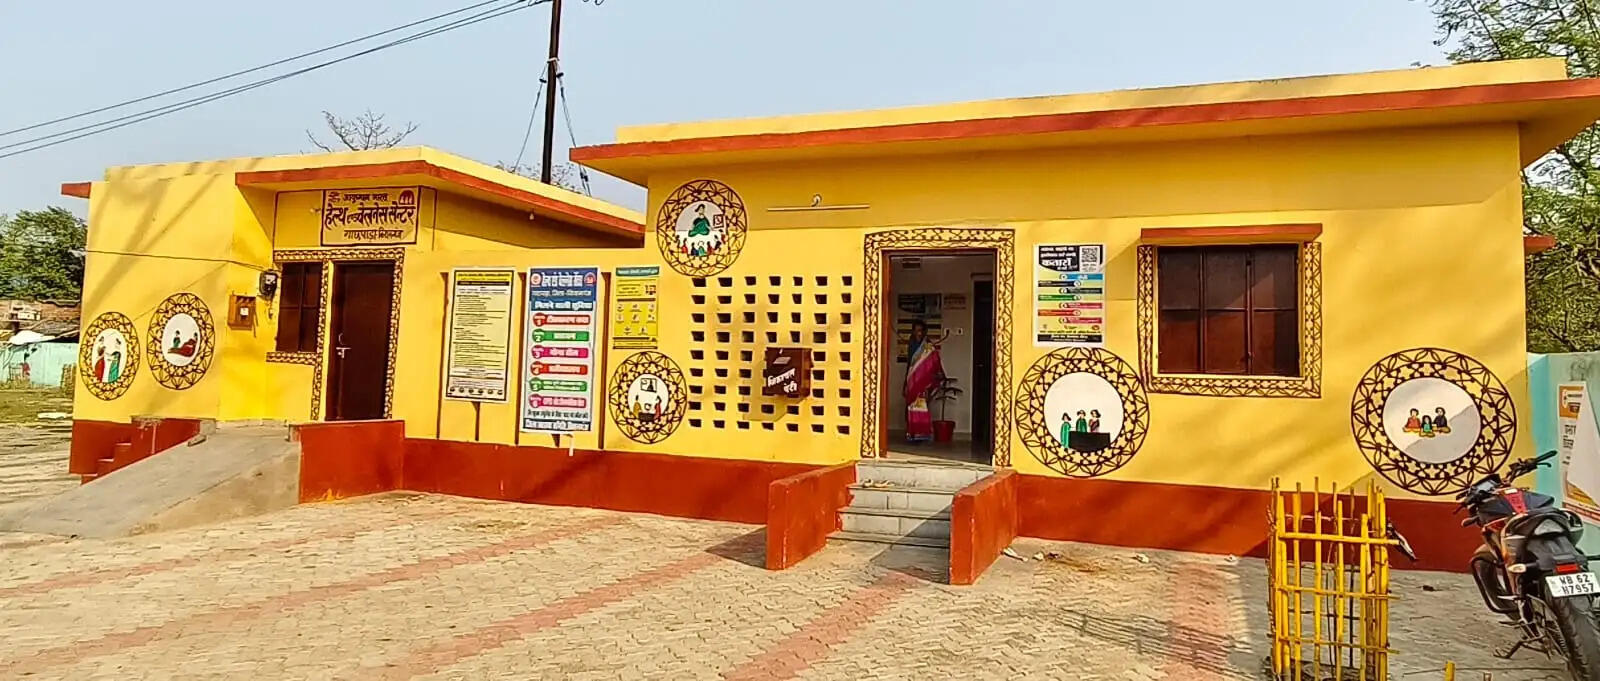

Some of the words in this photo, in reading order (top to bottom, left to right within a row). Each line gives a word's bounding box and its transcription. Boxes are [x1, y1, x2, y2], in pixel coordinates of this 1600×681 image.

[325, 203, 348, 230] हेल्थ
[1559, 576, 1573, 585] WB
[1576, 574, 1591, 583] 62
